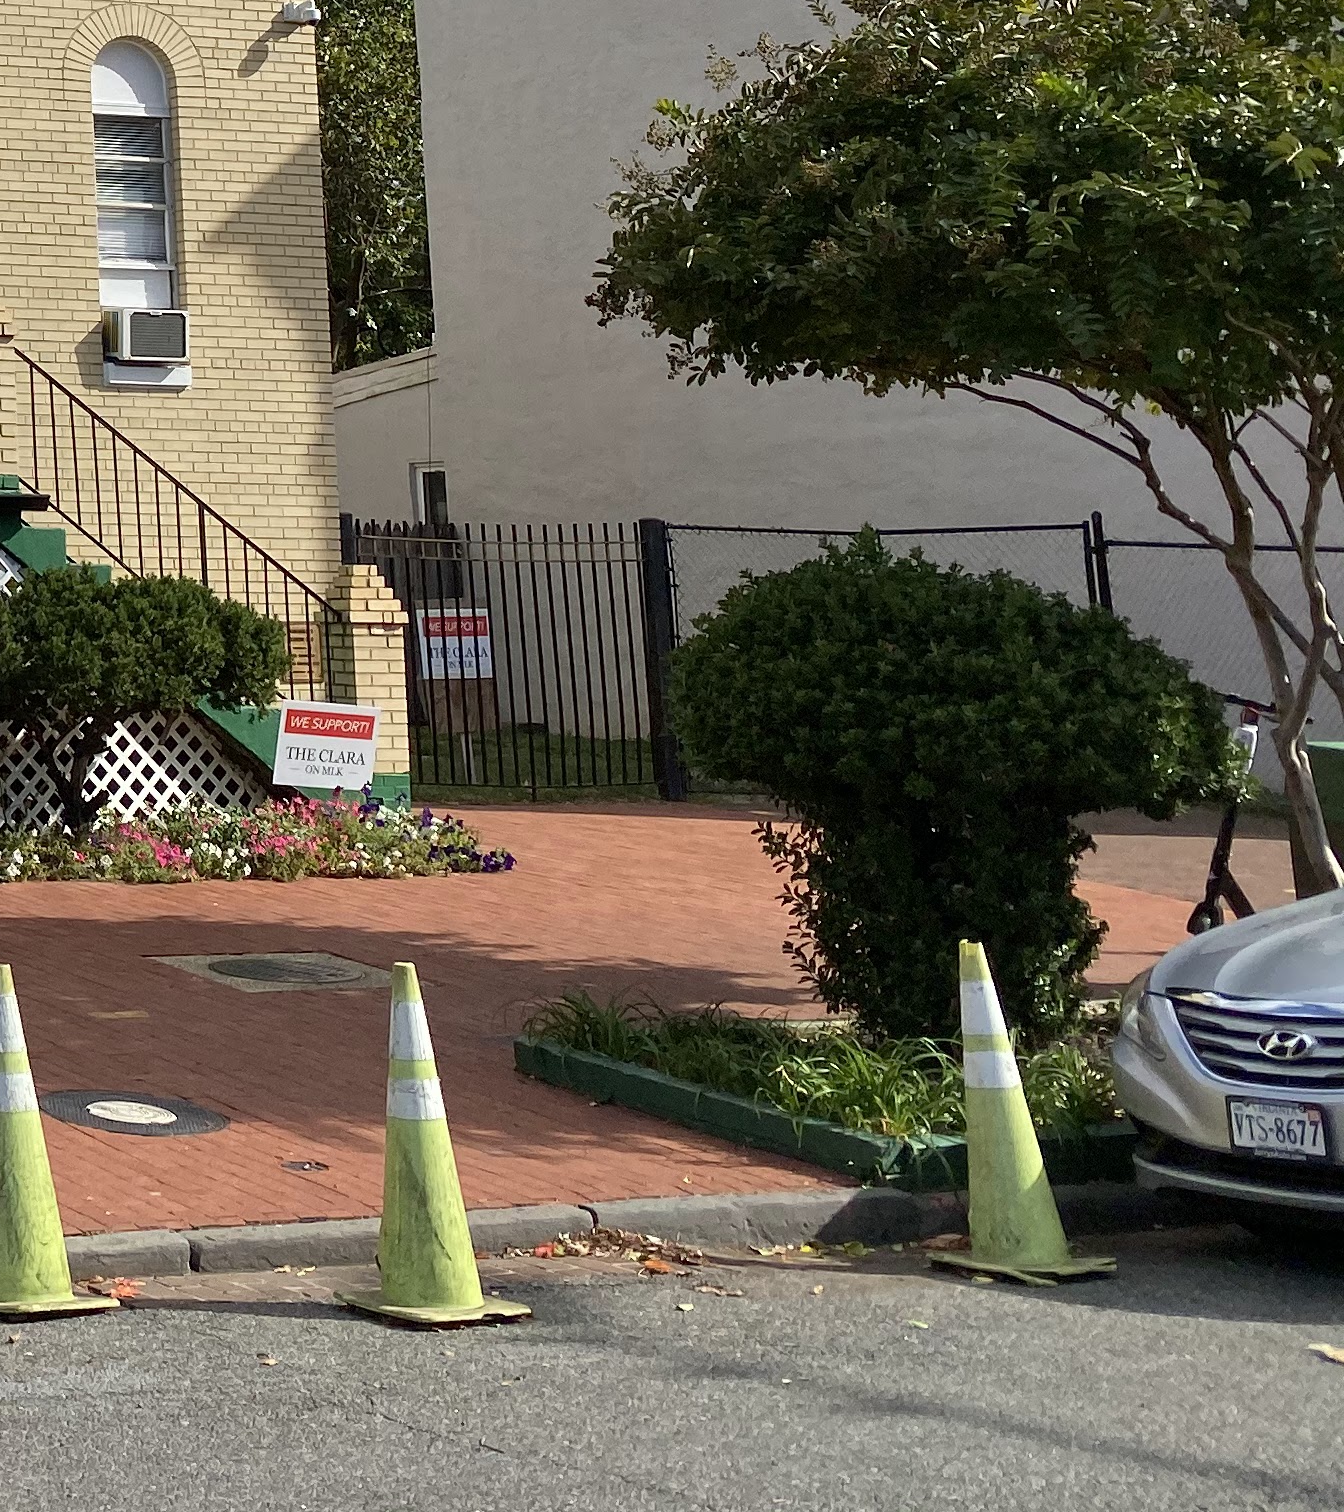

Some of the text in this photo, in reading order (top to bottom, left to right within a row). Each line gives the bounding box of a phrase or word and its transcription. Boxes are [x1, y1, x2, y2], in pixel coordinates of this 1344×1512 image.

[290, 715, 371, 734] WE SUPPORT!
[286, 746, 366, 766] THE CLARA
[304, 764, 344, 777] ON MLK
[1233, 1112, 1319, 1147] VTS-8677
